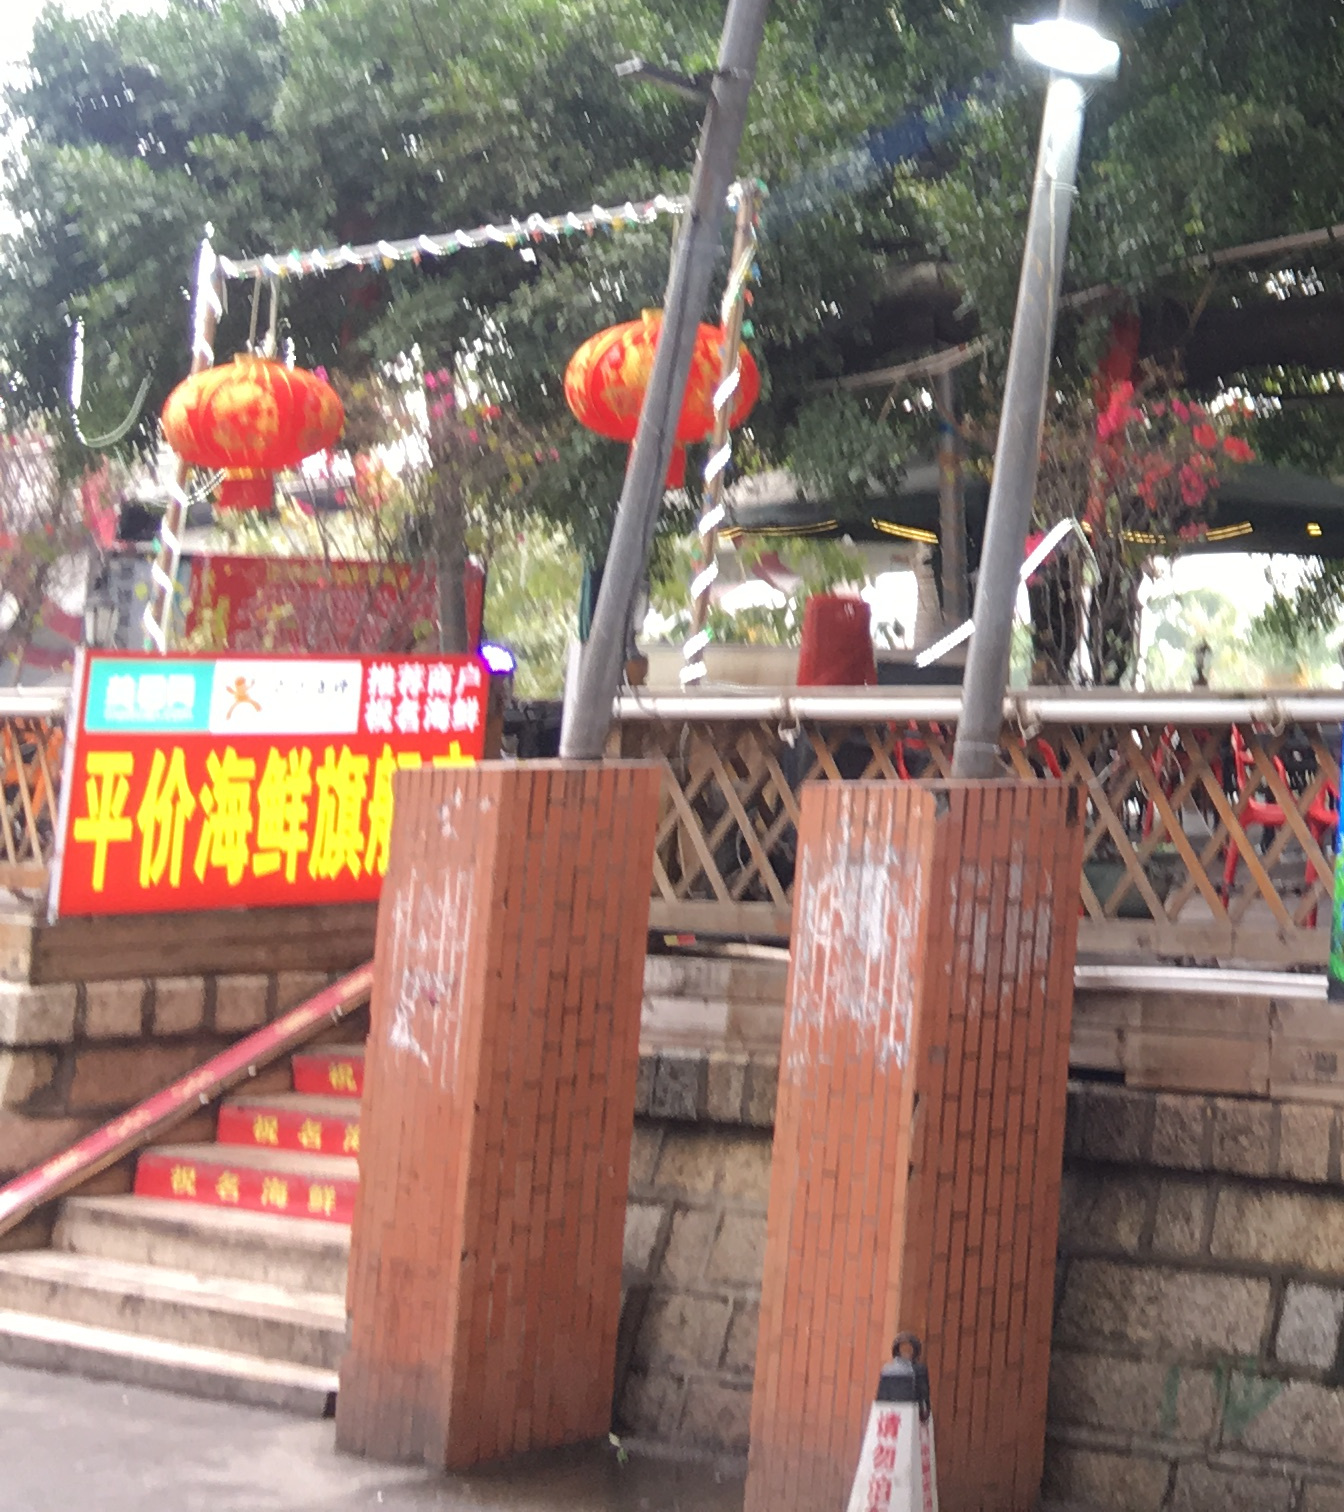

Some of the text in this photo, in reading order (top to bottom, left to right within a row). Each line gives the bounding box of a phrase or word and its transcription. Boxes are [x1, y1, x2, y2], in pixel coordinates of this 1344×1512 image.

[72, 740, 476, 892] 平价海鲜旗
[864, 1410, 902, 1512] 请勿泊
